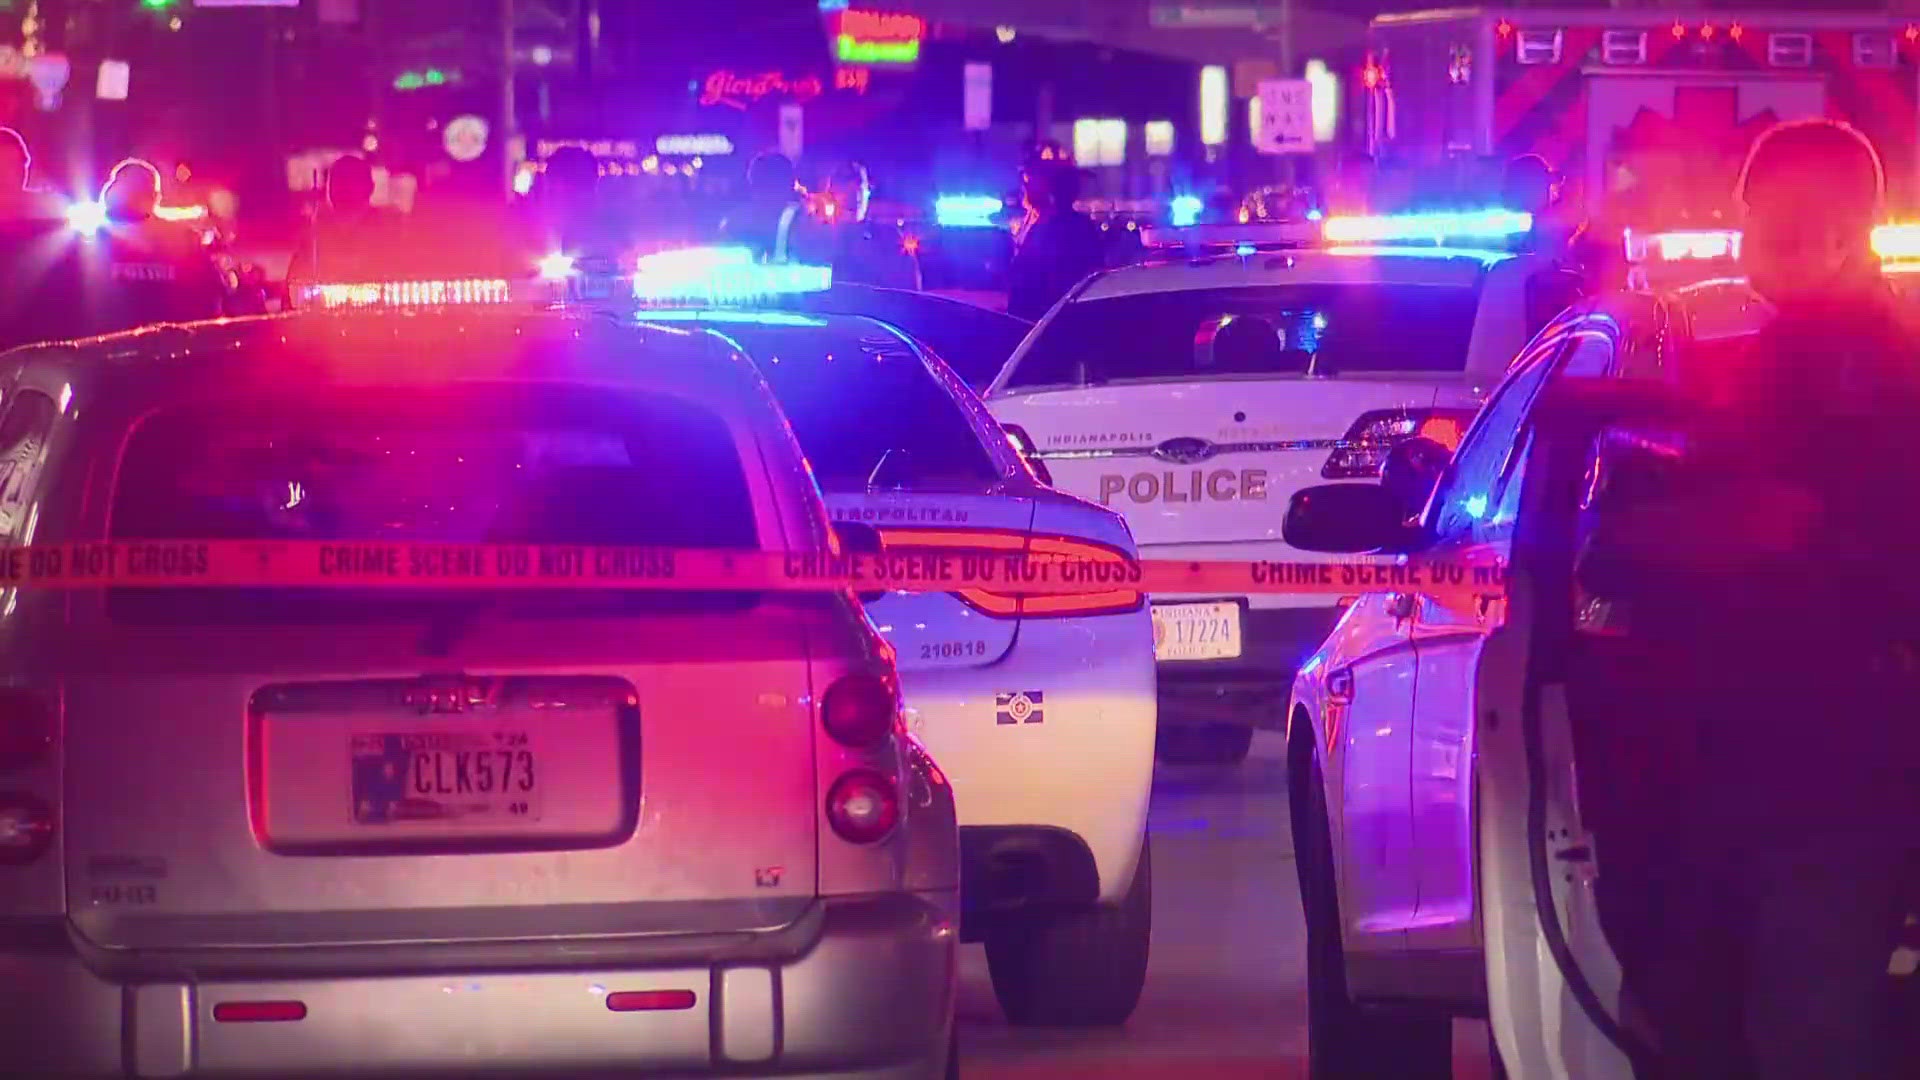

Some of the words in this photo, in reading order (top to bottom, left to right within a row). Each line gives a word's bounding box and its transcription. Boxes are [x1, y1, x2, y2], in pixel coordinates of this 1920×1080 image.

[1048, 432, 1152, 445] INDIANAPOLIS
[1100, 469, 1268, 506] POLICE
[127, 544, 208, 576] CROSS
[319, 546, 398, 576] CRIME
[409, 546, 485, 576] SCENE
[498, 547, 529, 577] DO
[539, 547, 583, 577] NOT
[594, 547, 675, 578] CROSS
[784, 554, 862, 580] CRIME
[873, 555, 952, 582] SCENE
[961, 556, 994, 582] DO
[1004, 556, 1050, 583] NOT
[1060, 557, 1142, 583] CROSS
[1251, 560, 1332, 585] CRIME
[1341, 561, 1421, 586] SCENE
[1430, 562, 1464, 586] DO
[1473, 562, 1504, 586] NO
[1175, 618, 1230, 644] 17224
[415, 751, 534, 794] CLK573
